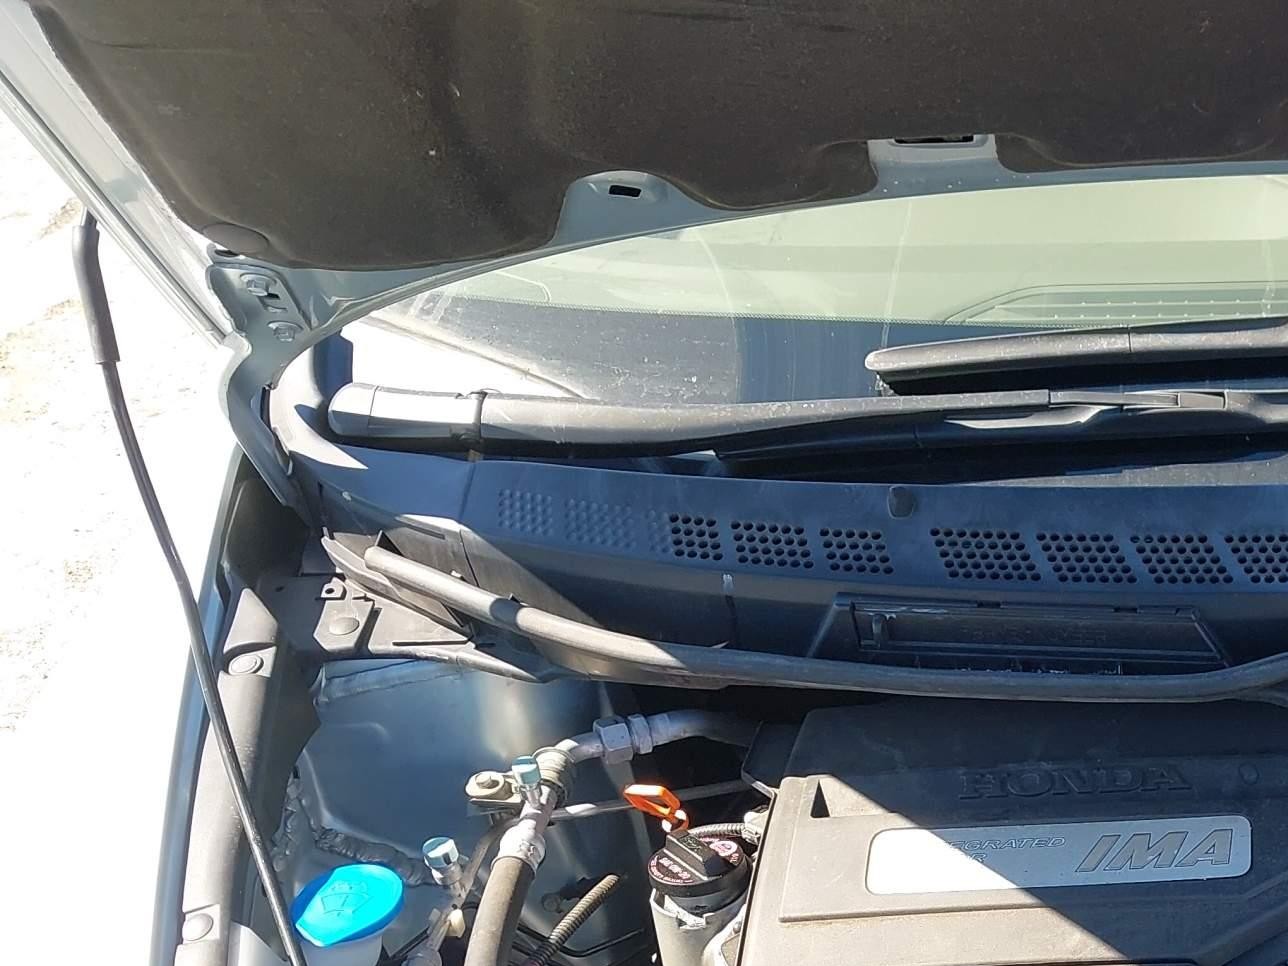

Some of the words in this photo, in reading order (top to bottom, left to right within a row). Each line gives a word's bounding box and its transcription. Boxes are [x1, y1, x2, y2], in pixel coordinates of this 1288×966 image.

[959, 765, 1192, 799] HONDA
[947, 836, 1065, 851] EGRATED
[1074, 828, 1234, 873] IMA
